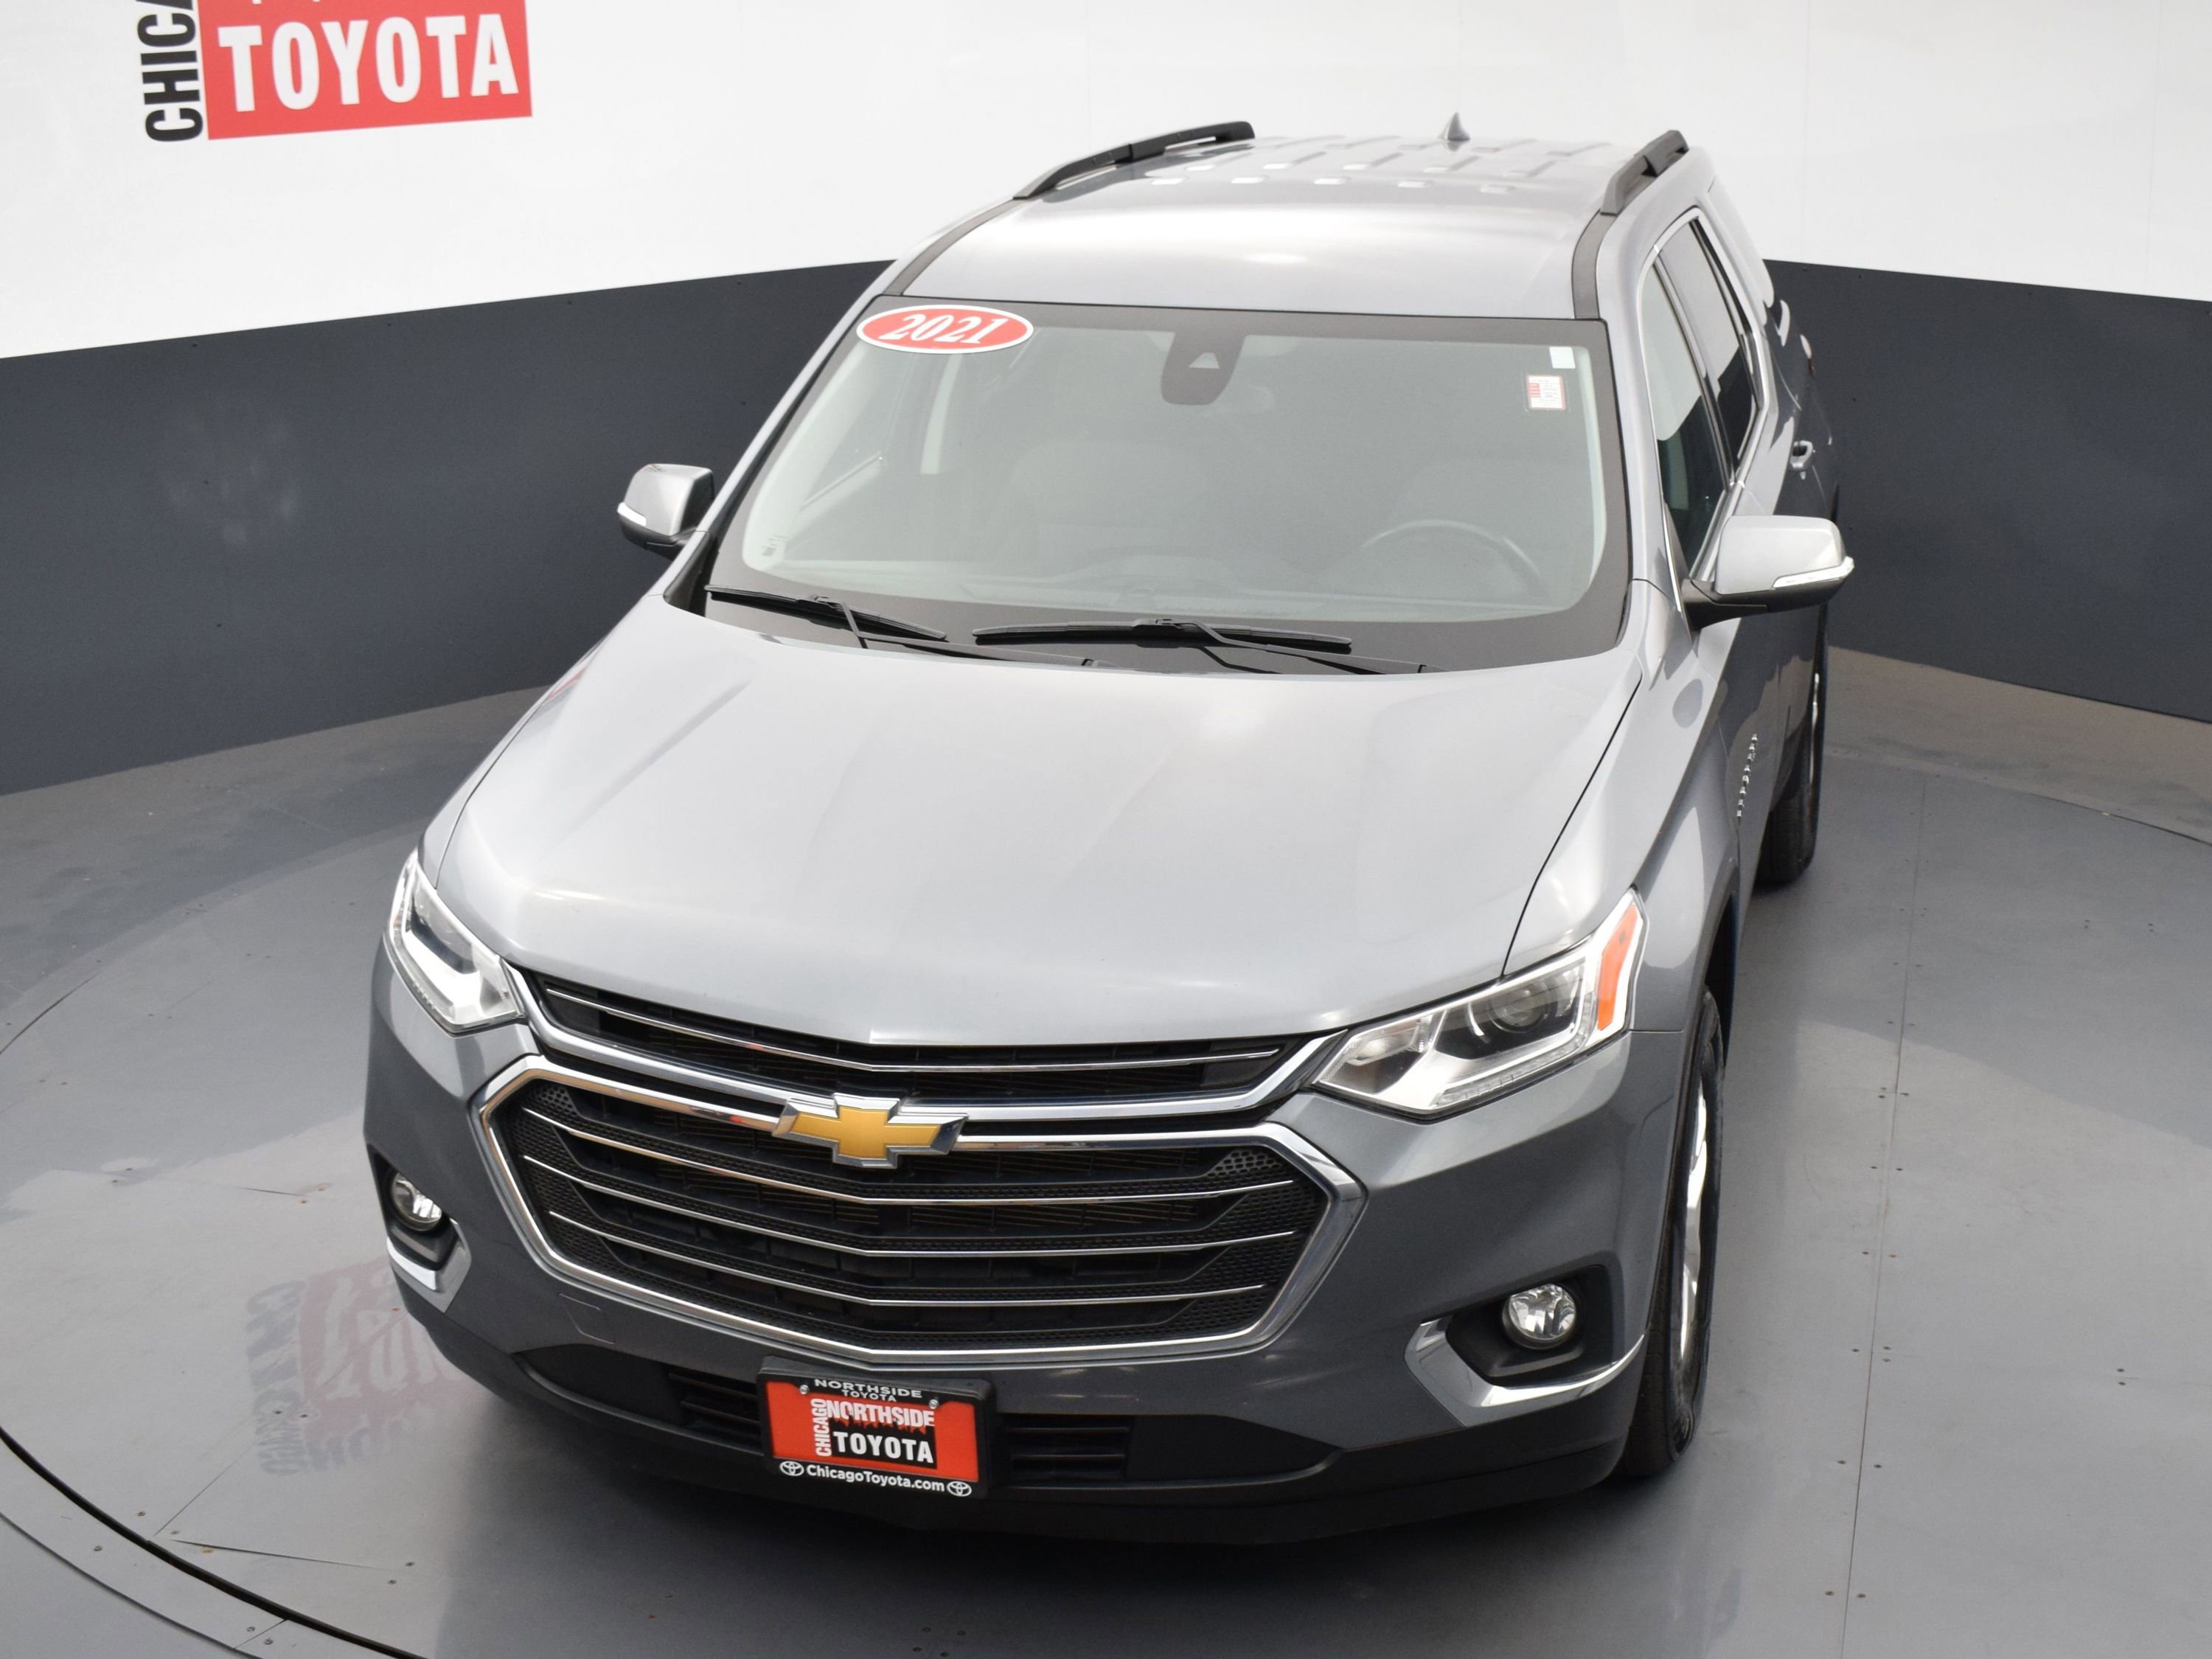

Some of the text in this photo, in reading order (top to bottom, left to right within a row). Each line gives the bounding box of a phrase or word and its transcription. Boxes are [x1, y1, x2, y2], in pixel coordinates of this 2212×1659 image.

[218, 13, 519, 112] TOYOTA
[878, 313, 1009, 344] 2021
[814, 1379, 922, 1398] NORTHSIDE
[841, 1389, 897, 1402] TOYOTA
[811, 1398, 832, 1457] CHICAGO
[826, 1399, 935, 1427] NORTHSIDE
[833, 1431, 933, 1464] TOYOTA
[807, 1464, 945, 1492] ChicagoToyota.com
